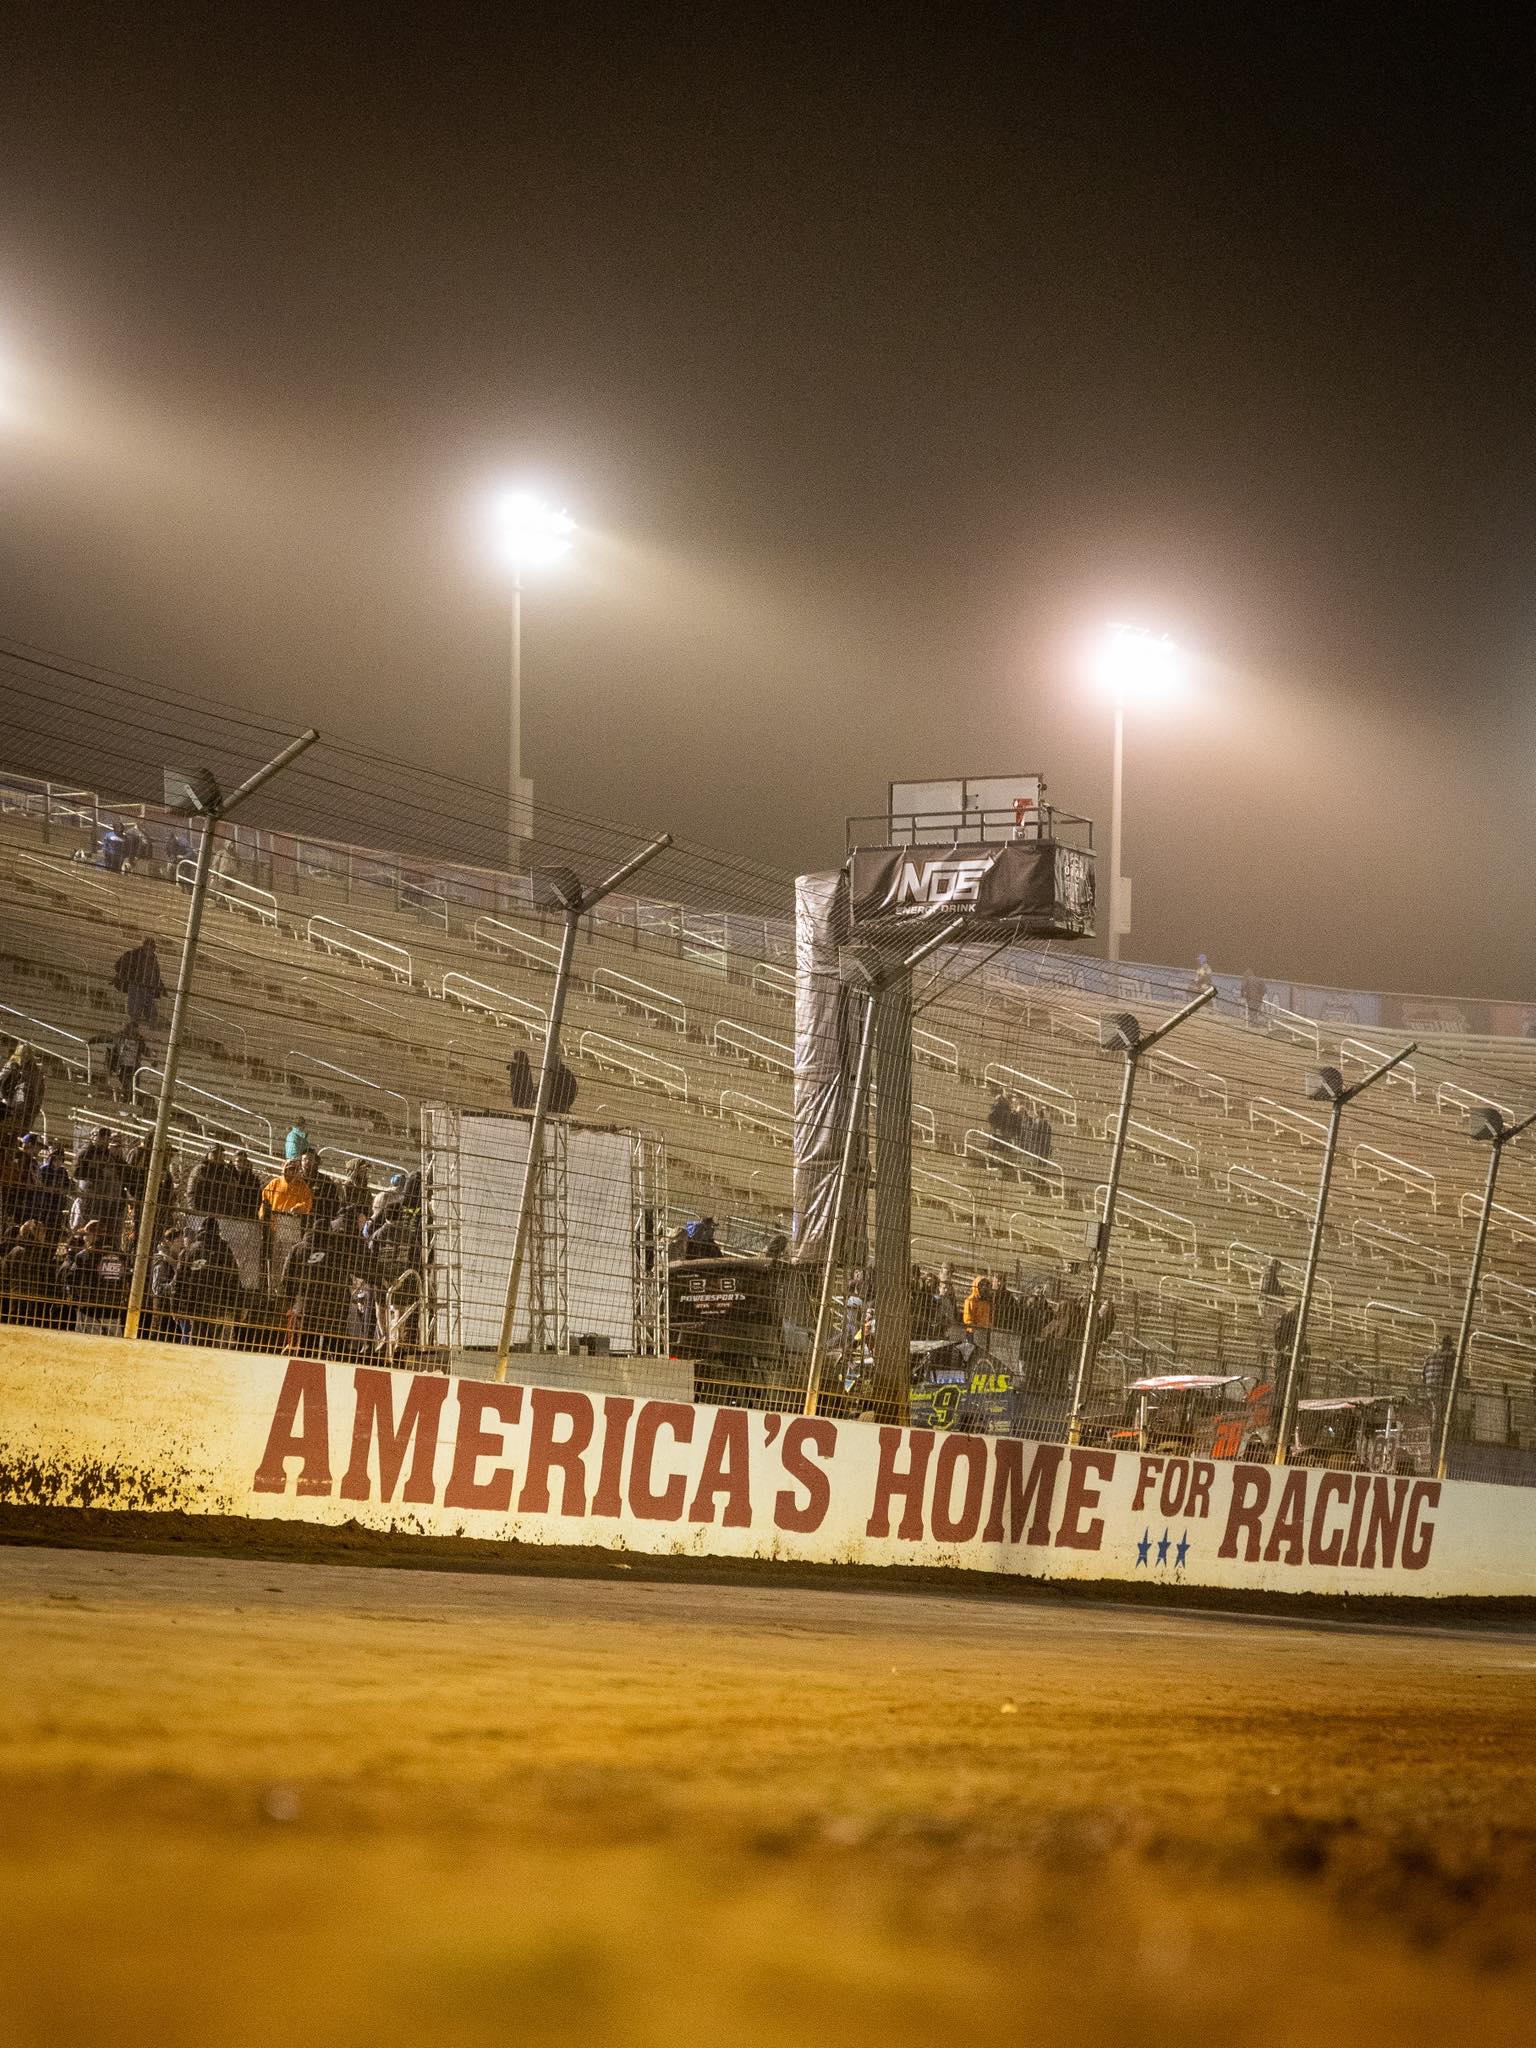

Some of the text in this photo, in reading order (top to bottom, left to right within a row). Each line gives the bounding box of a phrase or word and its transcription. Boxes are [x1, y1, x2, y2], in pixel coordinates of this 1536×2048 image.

[896, 857, 994, 902] NOS
[941, 904, 977, 913] DRINK
[680, 1293, 746, 1303] POWERSPORTS
[253, 1360, 1441, 1570] AMERICA'S HOME FOR RACING
